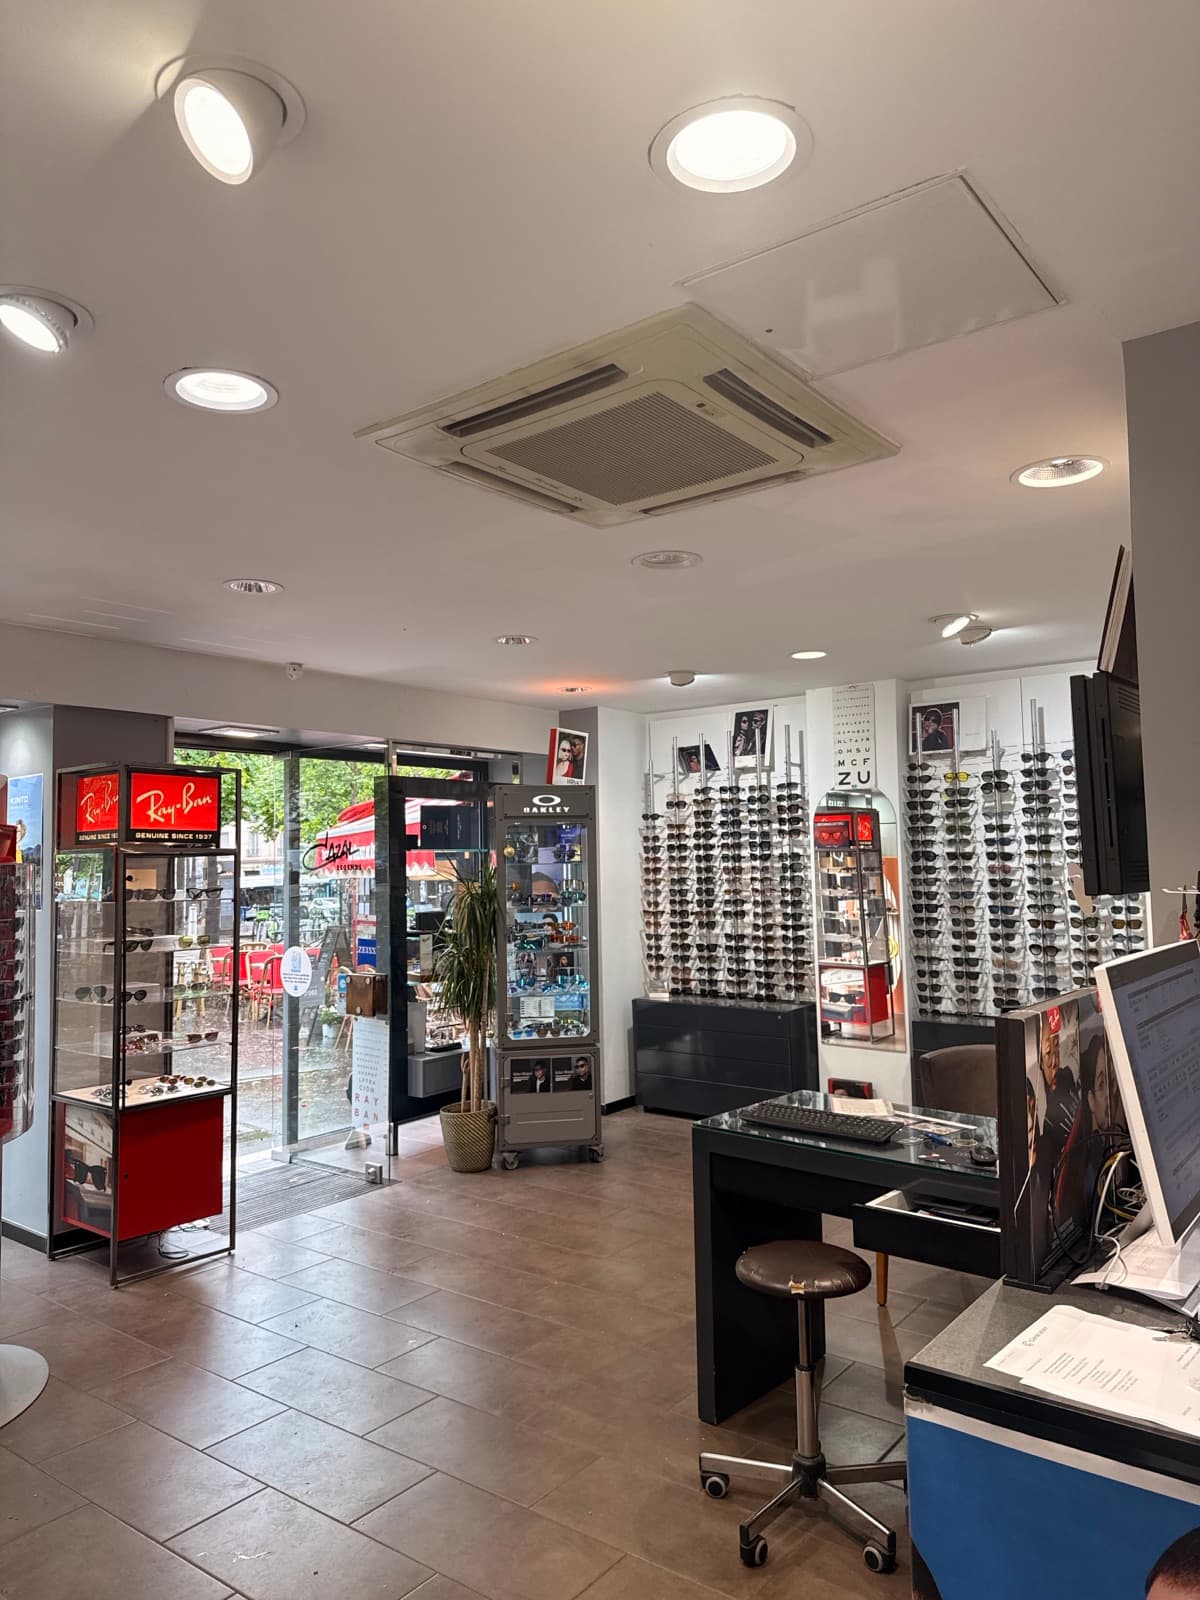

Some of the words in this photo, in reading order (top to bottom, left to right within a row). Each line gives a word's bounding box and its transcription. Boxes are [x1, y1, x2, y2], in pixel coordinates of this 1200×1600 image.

[838, 770, 870, 786] ZU
[136, 782, 213, 825] Ray-Ban
[523, 806, 570, 814] OAKLEY
[135, 832, 169, 840] GENUINE
[171, 832, 194, 840] SINCE
[358, 946, 377, 955] ZEISS
[354, 1092, 379, 1106] RAY
[354, 1108, 379, 1121] BAN
